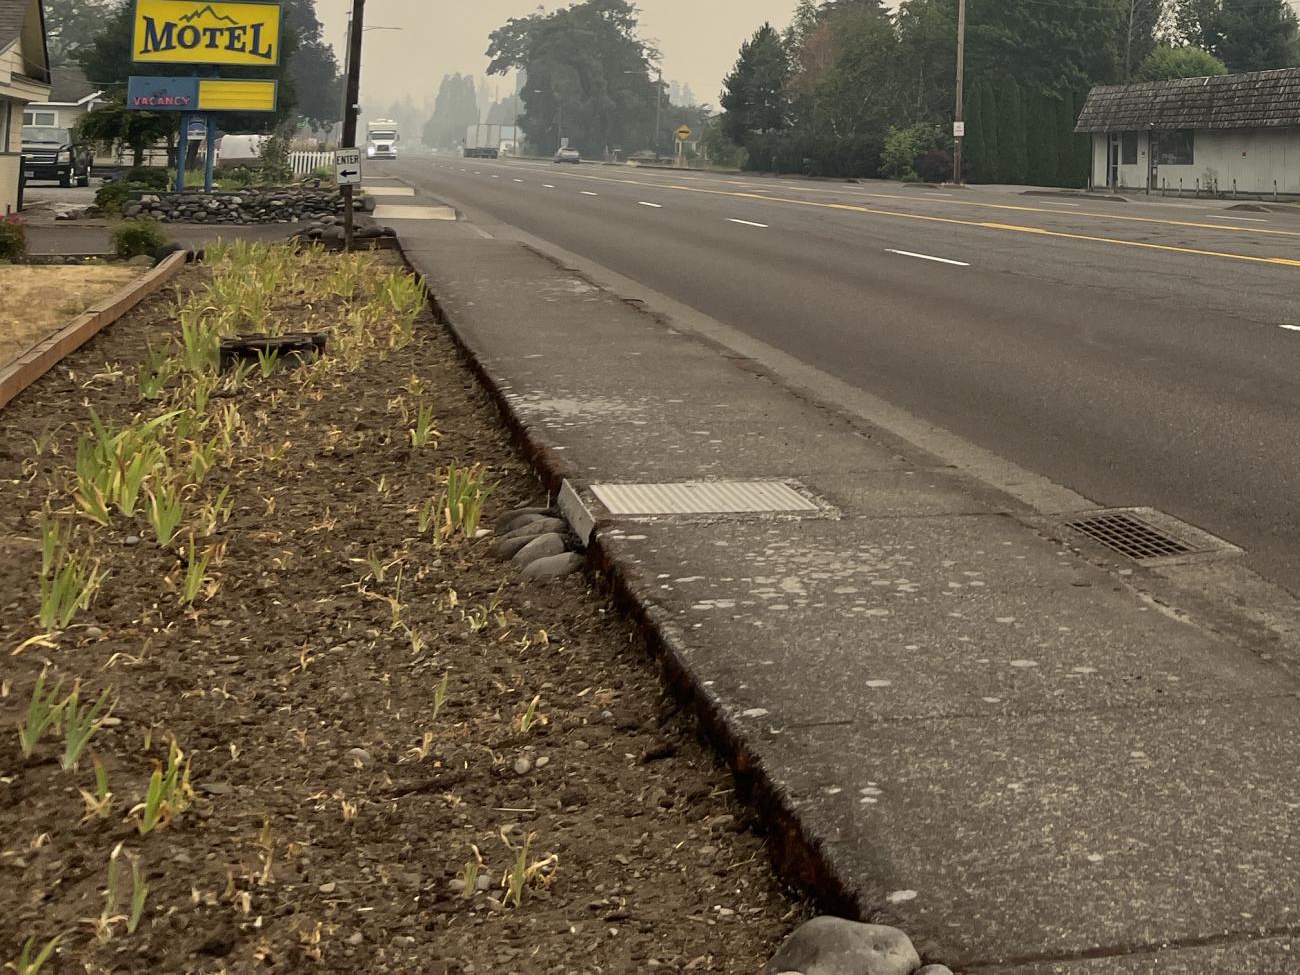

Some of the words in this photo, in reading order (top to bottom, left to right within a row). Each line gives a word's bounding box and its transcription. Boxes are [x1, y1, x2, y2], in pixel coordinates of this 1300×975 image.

[139, 15, 272, 59] MOTEL
[133, 97, 190, 106] VACANCY
[336, 155, 359, 165] ENTER
